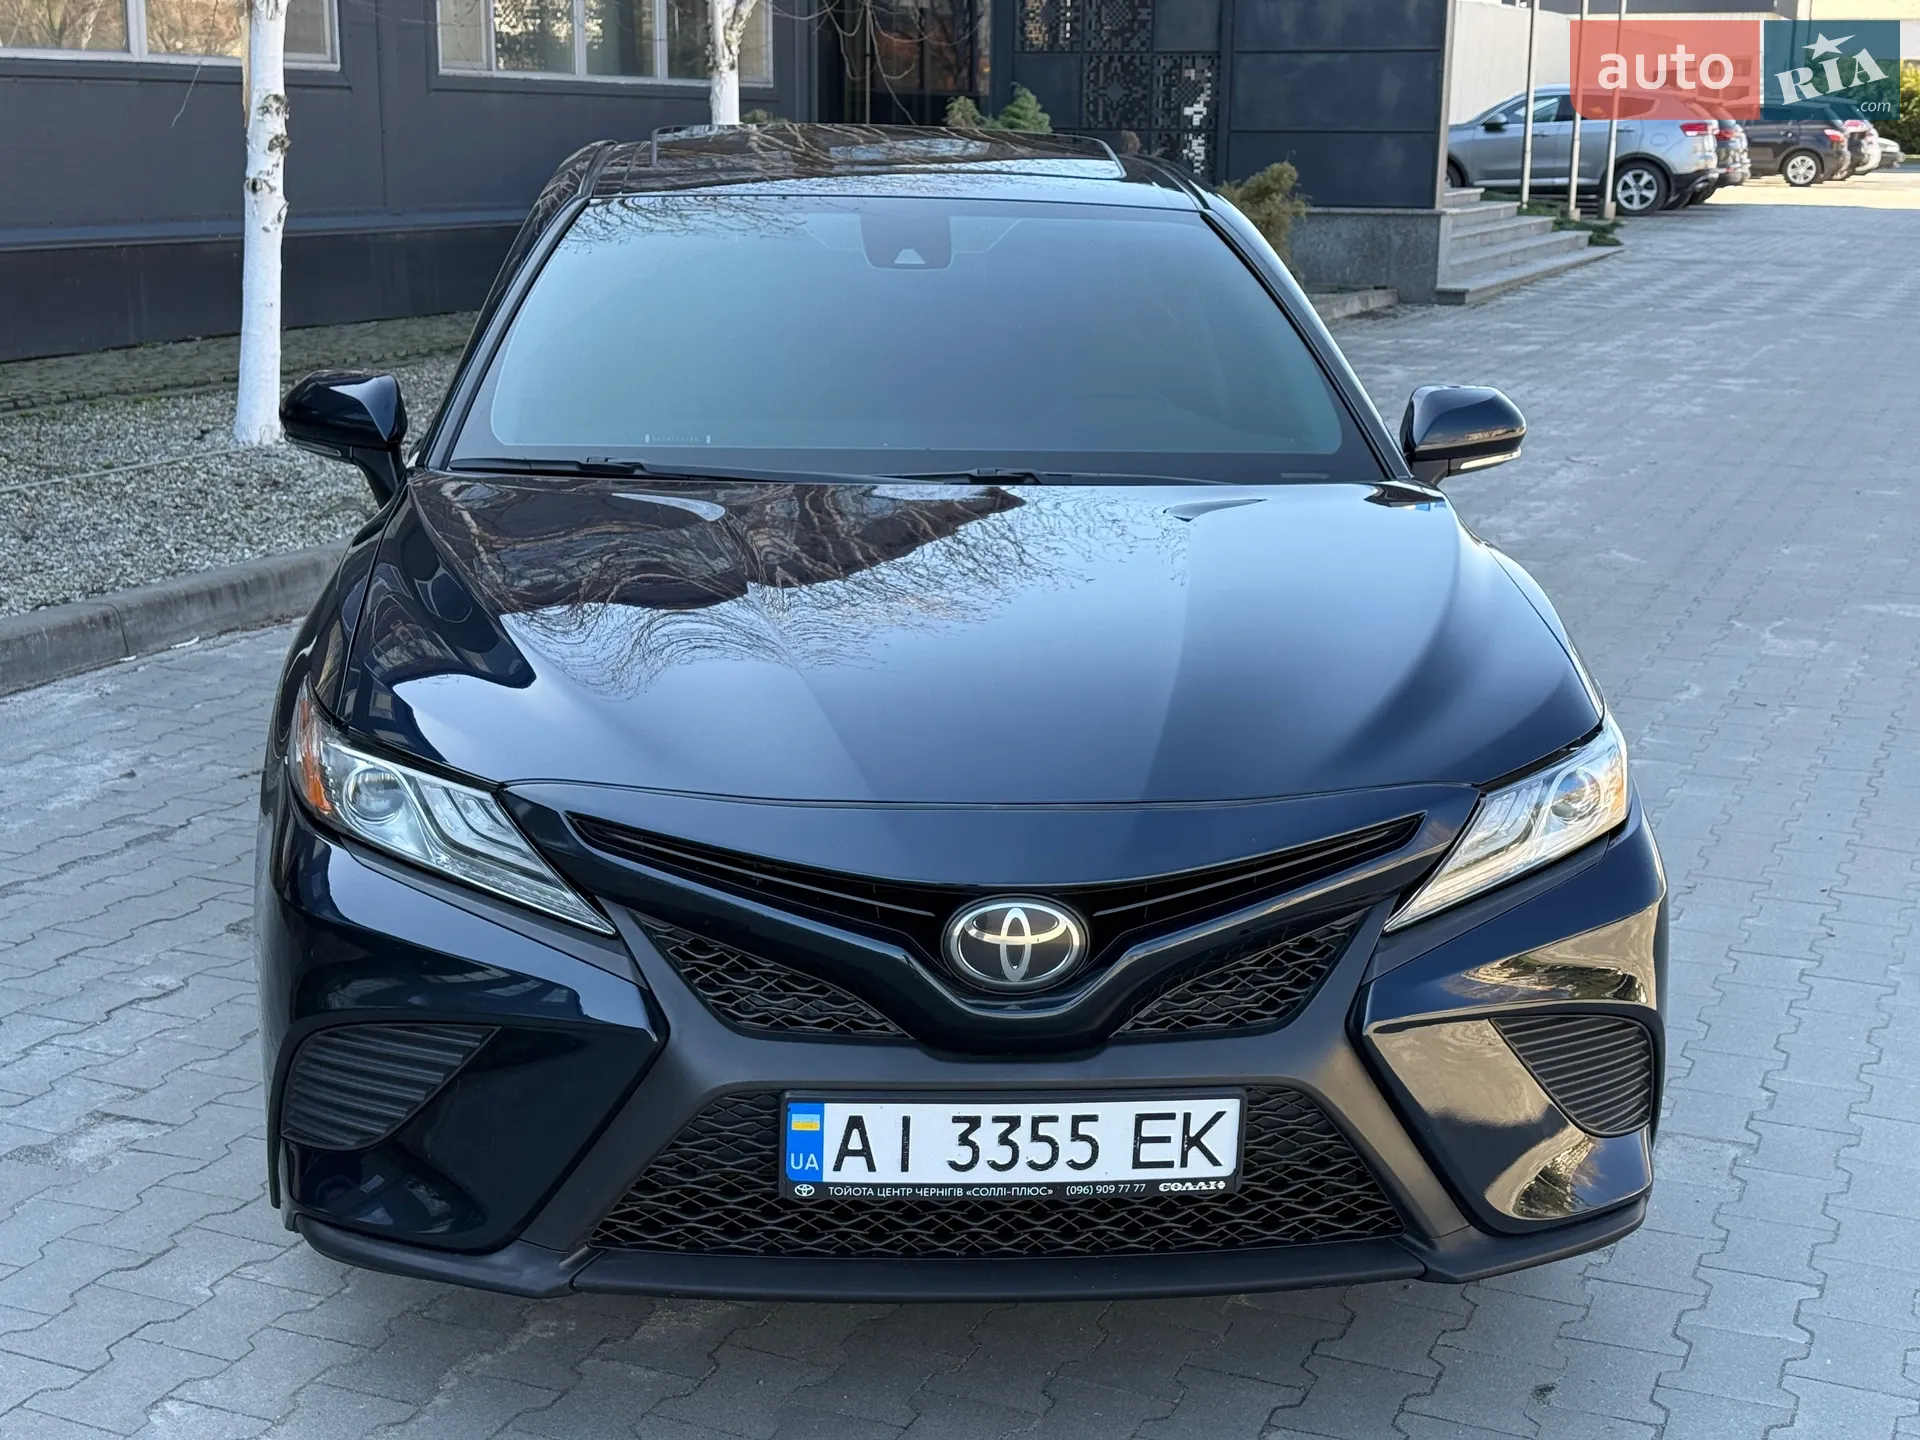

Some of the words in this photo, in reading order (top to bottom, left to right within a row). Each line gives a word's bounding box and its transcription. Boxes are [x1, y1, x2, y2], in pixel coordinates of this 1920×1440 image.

[946, 1113, 1099, 1173] 3355
[790, 1153, 819, 1171] UA
[828, 1185, 875, 1196] ТОЙОТА
[877, 1186, 913, 1198] ЦЕНТР
[916, 1186, 964, 1197] ЧЕРНІГІВ
[966, 1186, 1054, 1197] «СОЛЛІ-ПЛЮС»
[1066, 1185, 1094, 1196] (096)
[1095, 1184, 1116, 1195] 909
[1118, 1184, 1131, 1194] 77
[1133, 1183, 1147, 1193] 77
